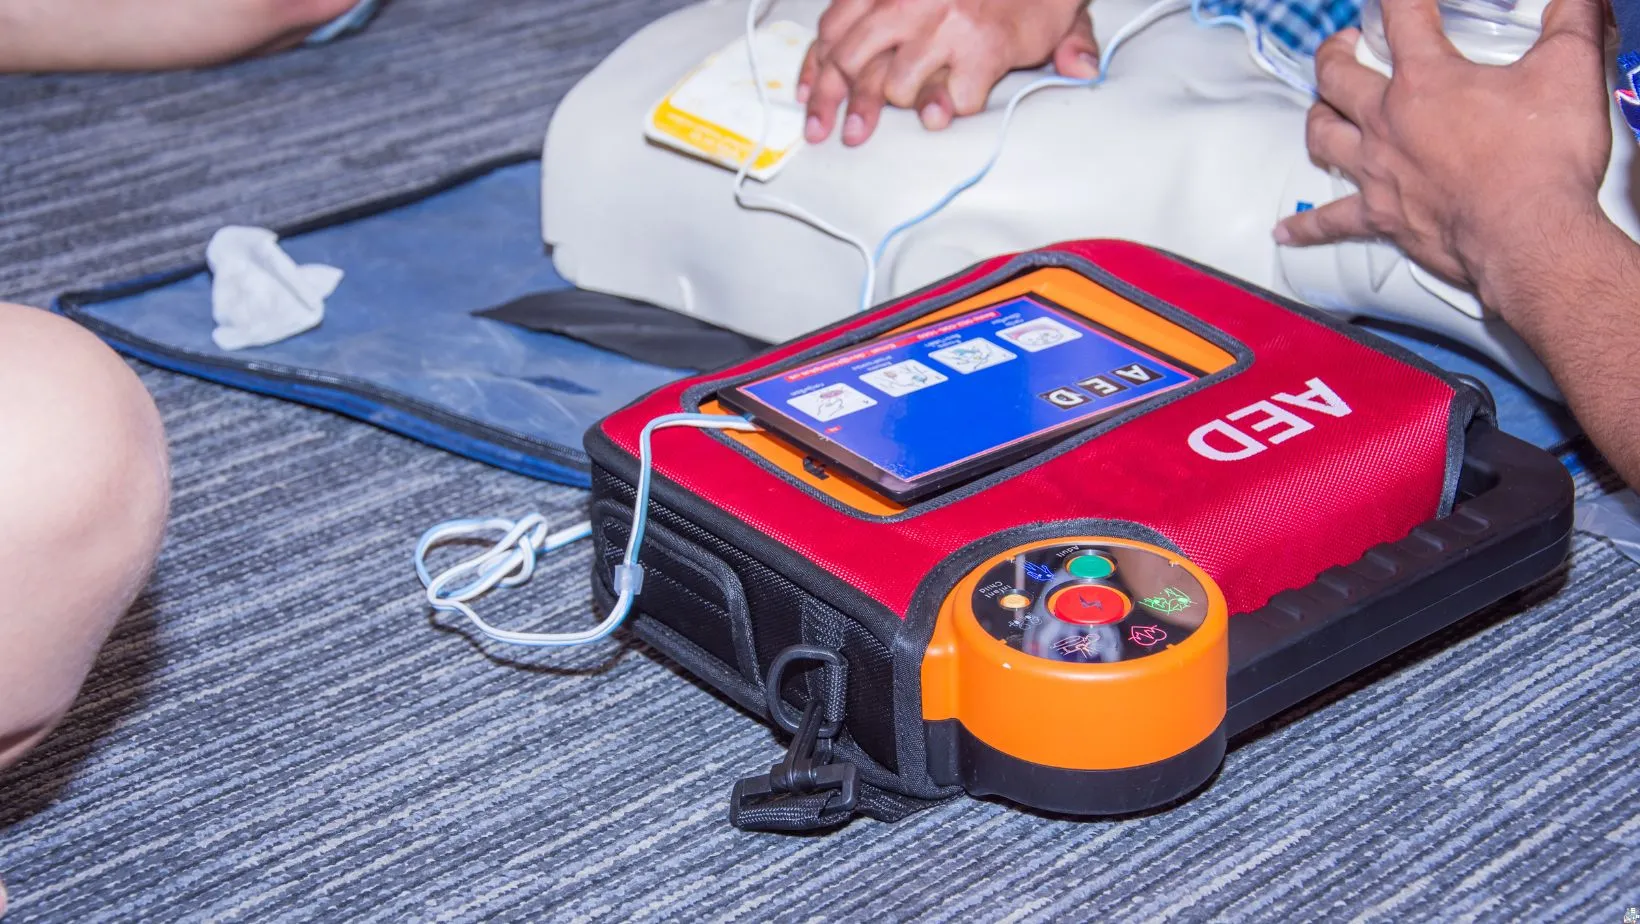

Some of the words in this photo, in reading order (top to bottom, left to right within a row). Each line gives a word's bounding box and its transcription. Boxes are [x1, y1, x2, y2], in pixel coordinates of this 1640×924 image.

[1048, 364, 1151, 406] AED
[1187, 377, 1353, 461] AED
[1055, 545, 1080, 558] Adult
[978, 581, 1003, 594] Child
[984, 585, 1012, 599] Infant
